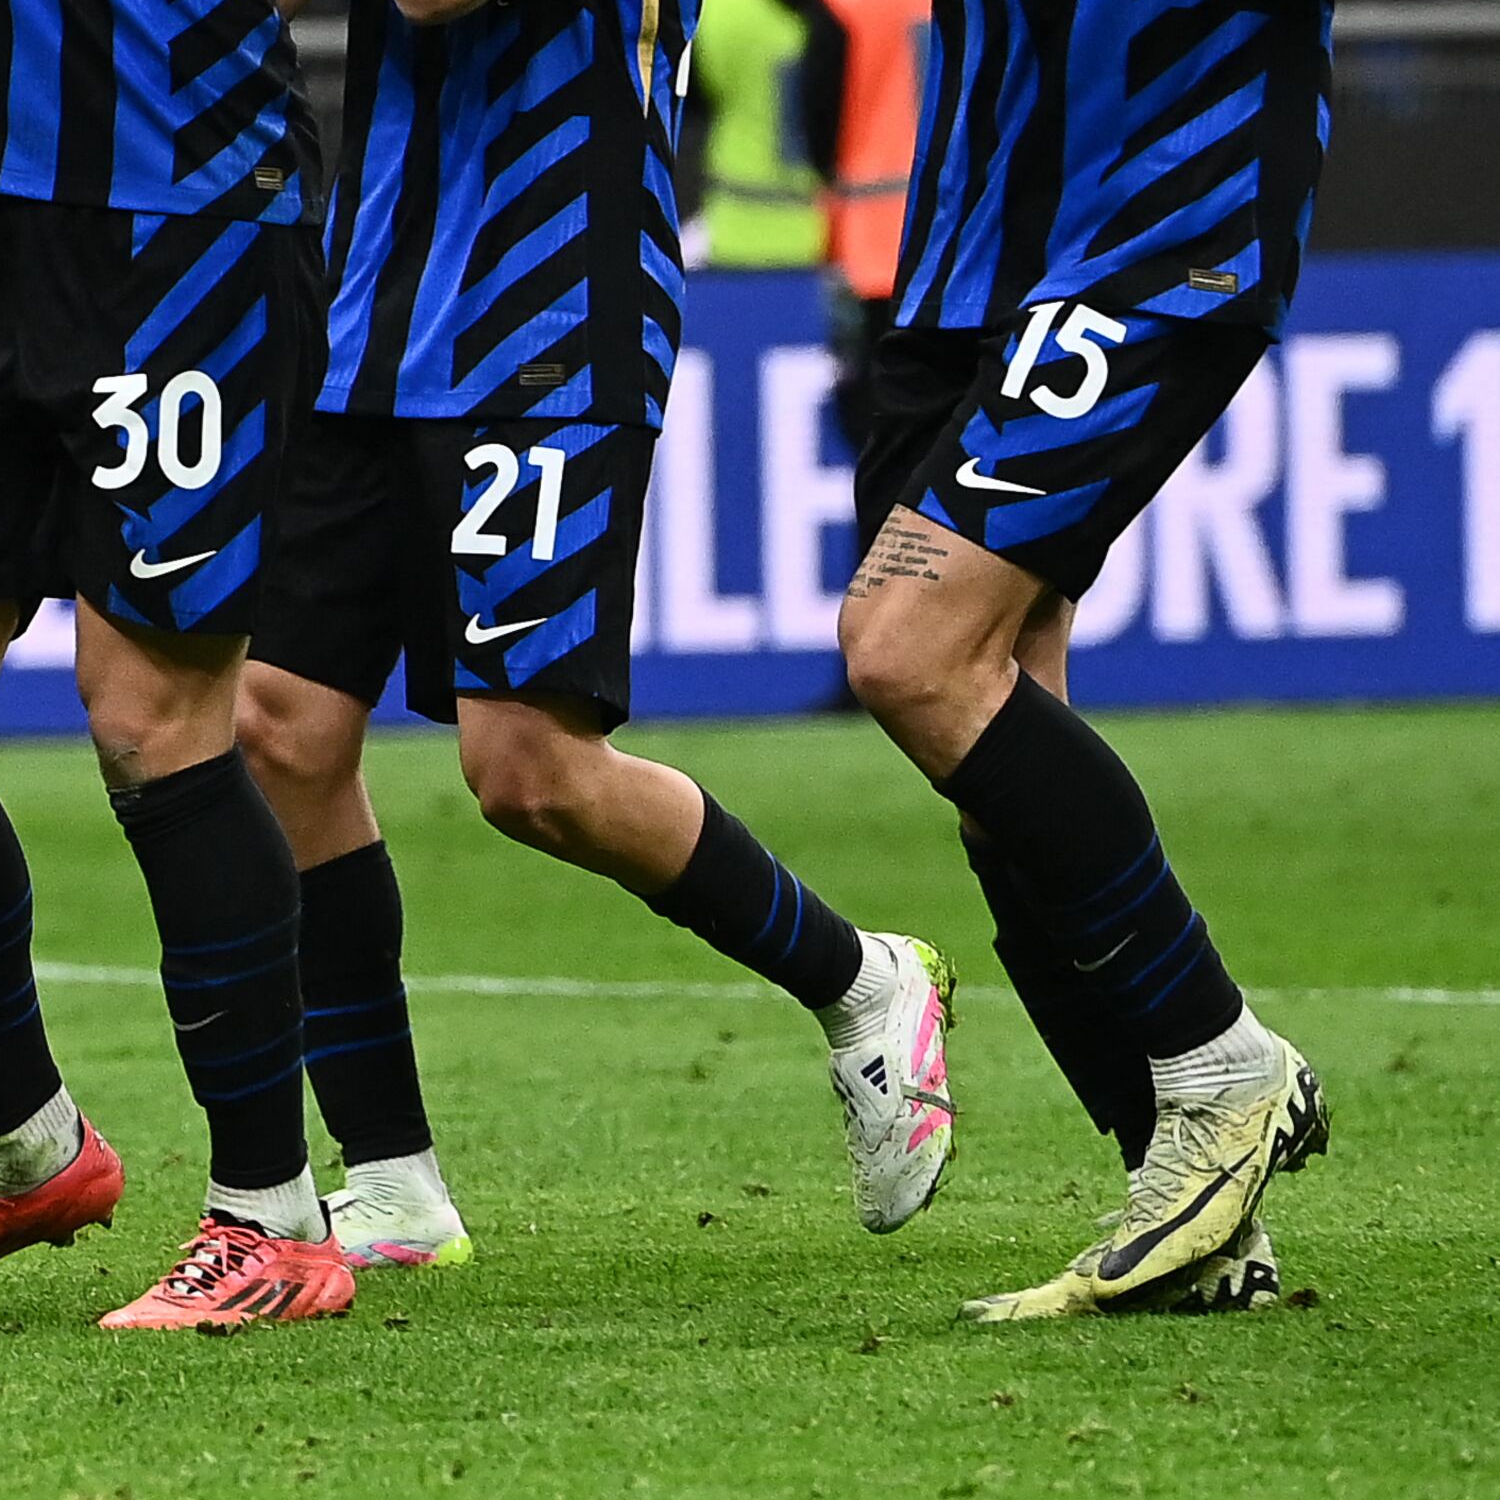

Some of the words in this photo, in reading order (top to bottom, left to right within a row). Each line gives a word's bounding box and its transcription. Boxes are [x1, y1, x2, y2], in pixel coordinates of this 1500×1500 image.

[999, 301, 1127, 420] 15
[90, 371, 222, 490] 30
[450, 443, 566, 562] 21
[631, 347, 858, 655] LE
